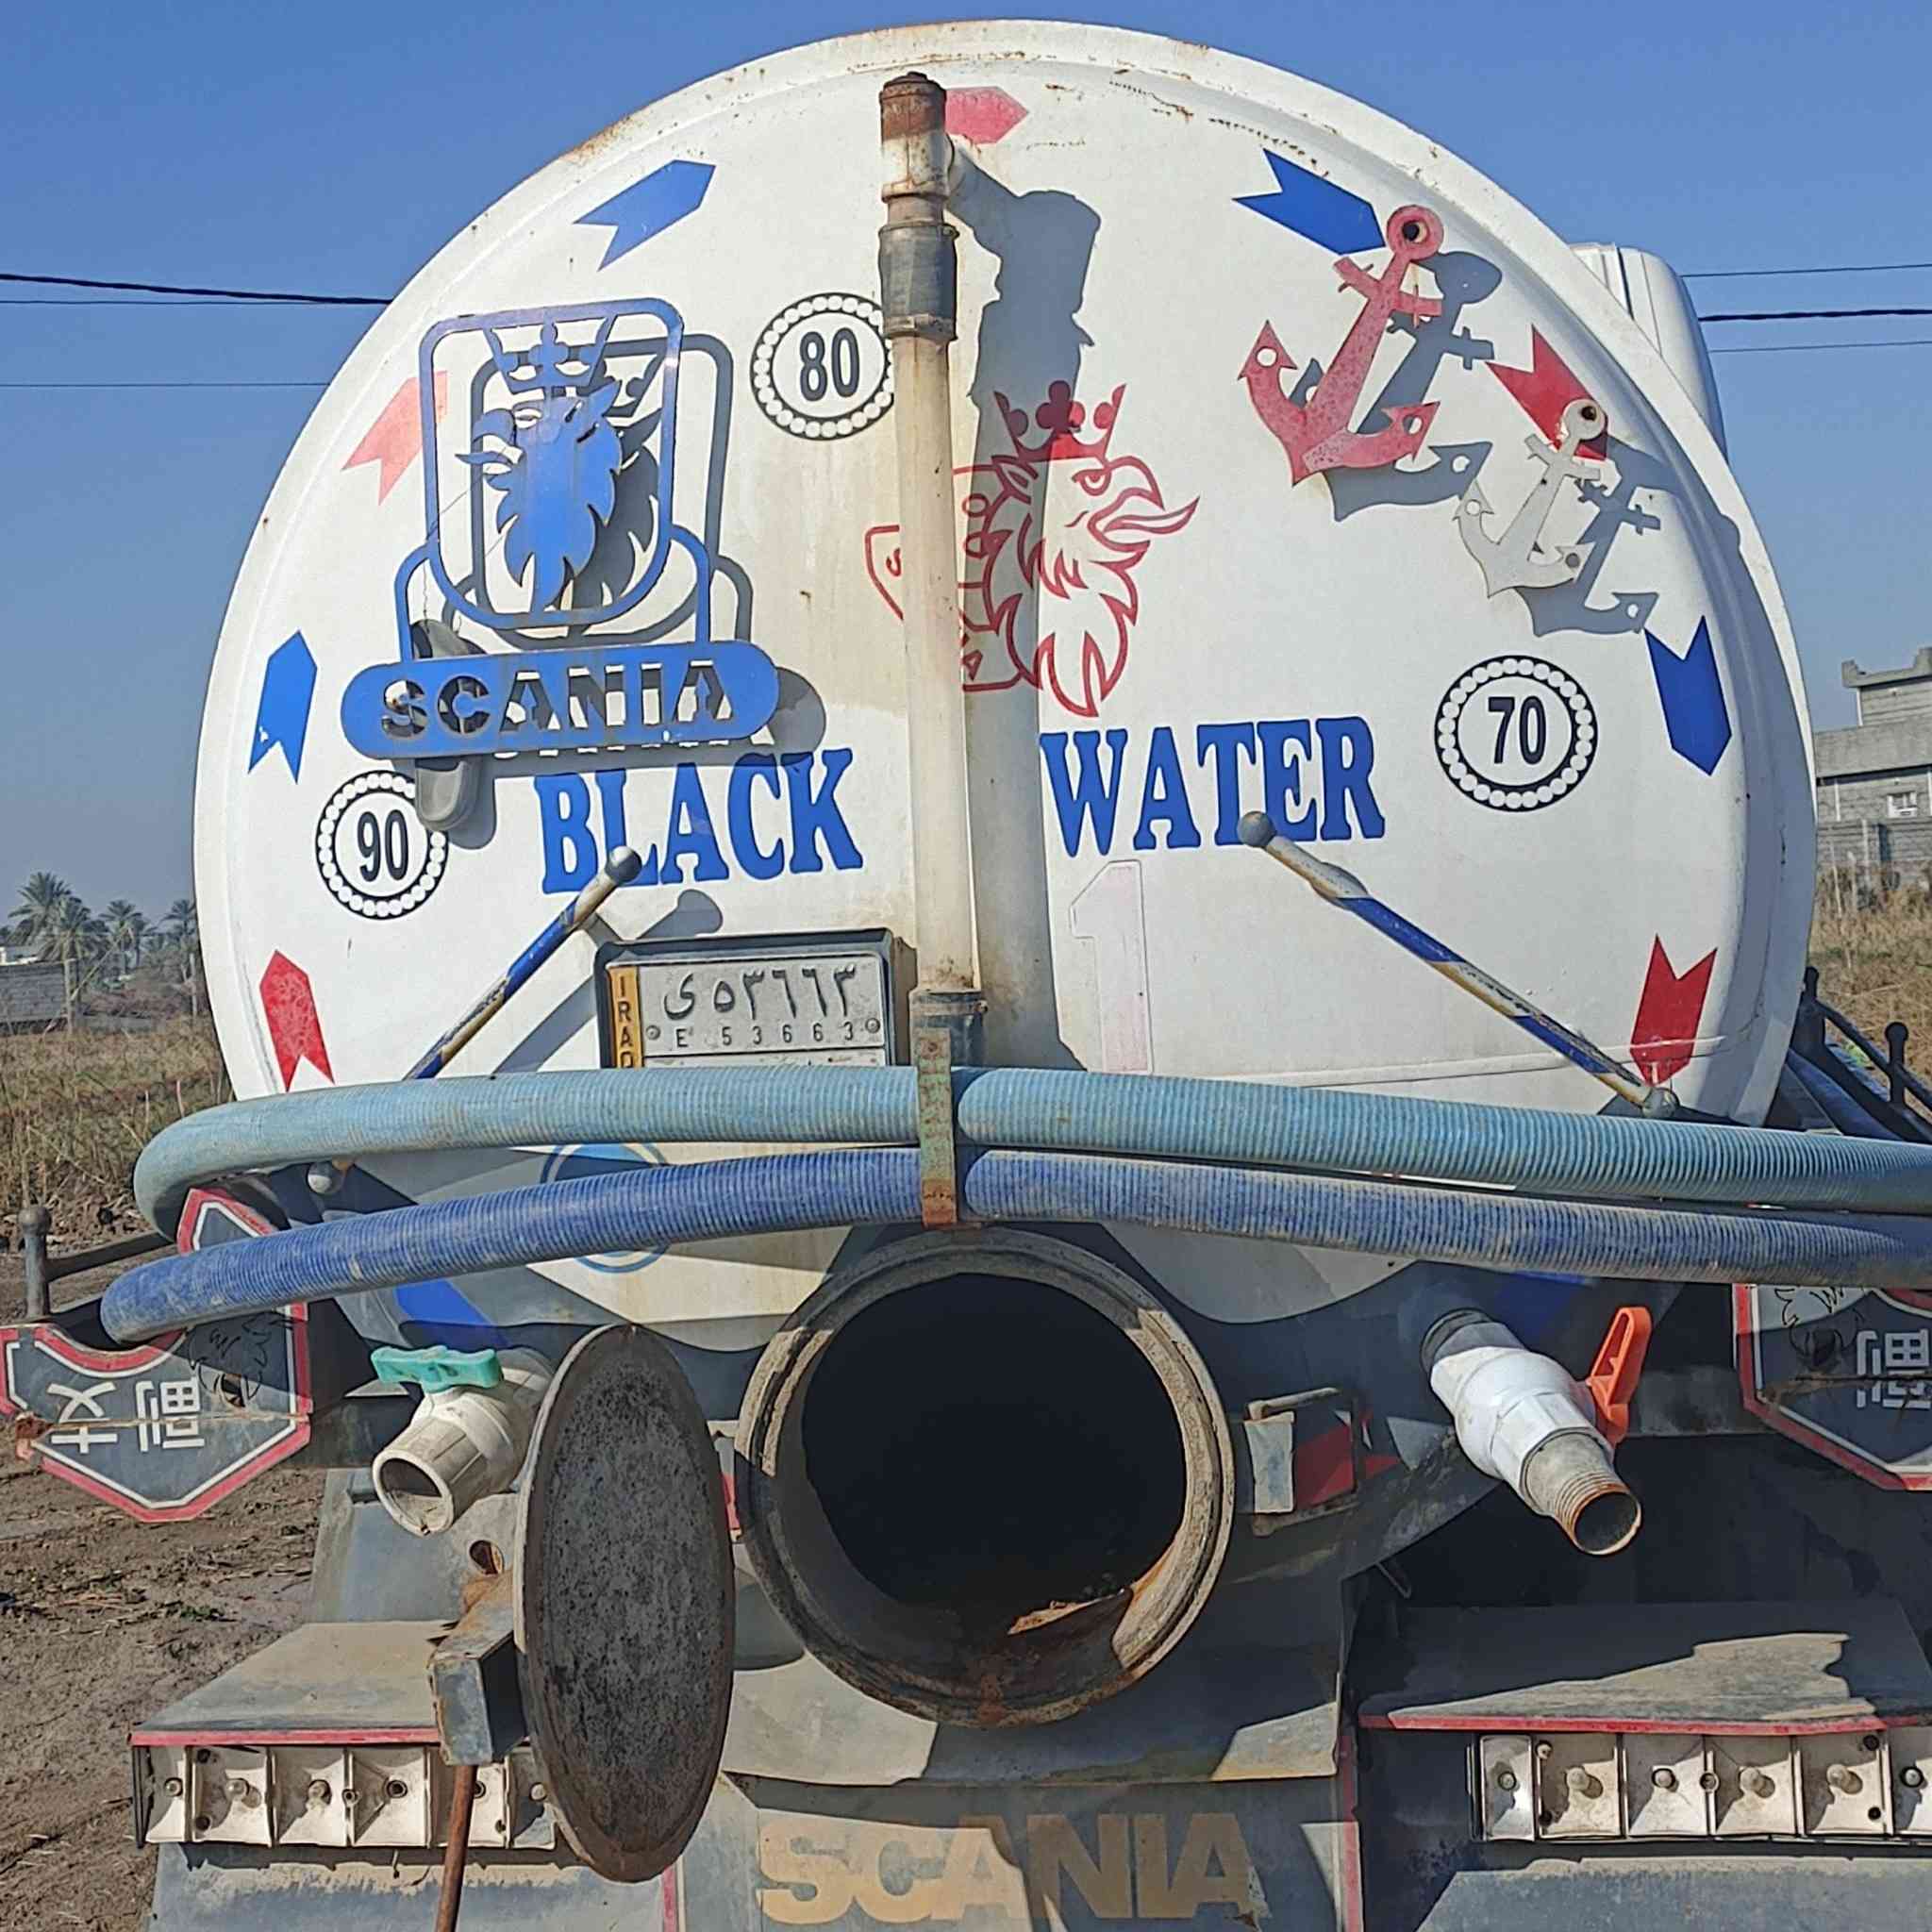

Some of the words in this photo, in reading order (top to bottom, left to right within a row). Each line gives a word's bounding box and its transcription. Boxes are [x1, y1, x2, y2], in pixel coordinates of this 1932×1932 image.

[800, 327, 860, 402] 80
[380, 659, 735, 738] SCANIA
[1488, 695, 1547, 765] 70
[534, 747, 864, 894] BLACK
[1040, 715, 1386, 858] WATER
[357, 809, 409, 882] 90
[722, 1021, 855, 1046] 53663
[758, 1812, 1264, 1925] SCANIA
